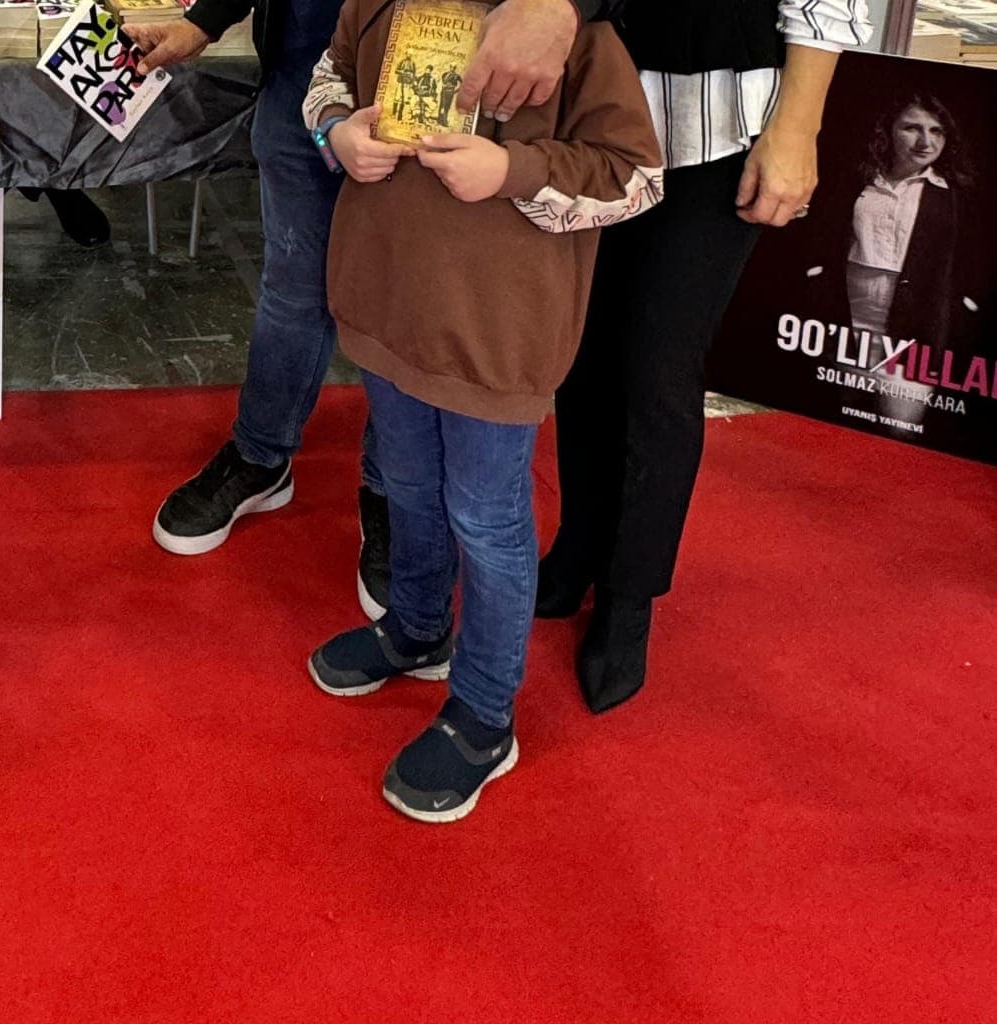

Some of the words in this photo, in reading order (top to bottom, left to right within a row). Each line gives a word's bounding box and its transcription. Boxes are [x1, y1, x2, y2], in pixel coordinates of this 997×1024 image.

[417, 26, 461, 43] HASAN
[816, 366, 876, 394] SOLMAZ
[923, 392, 967, 416] KARA
